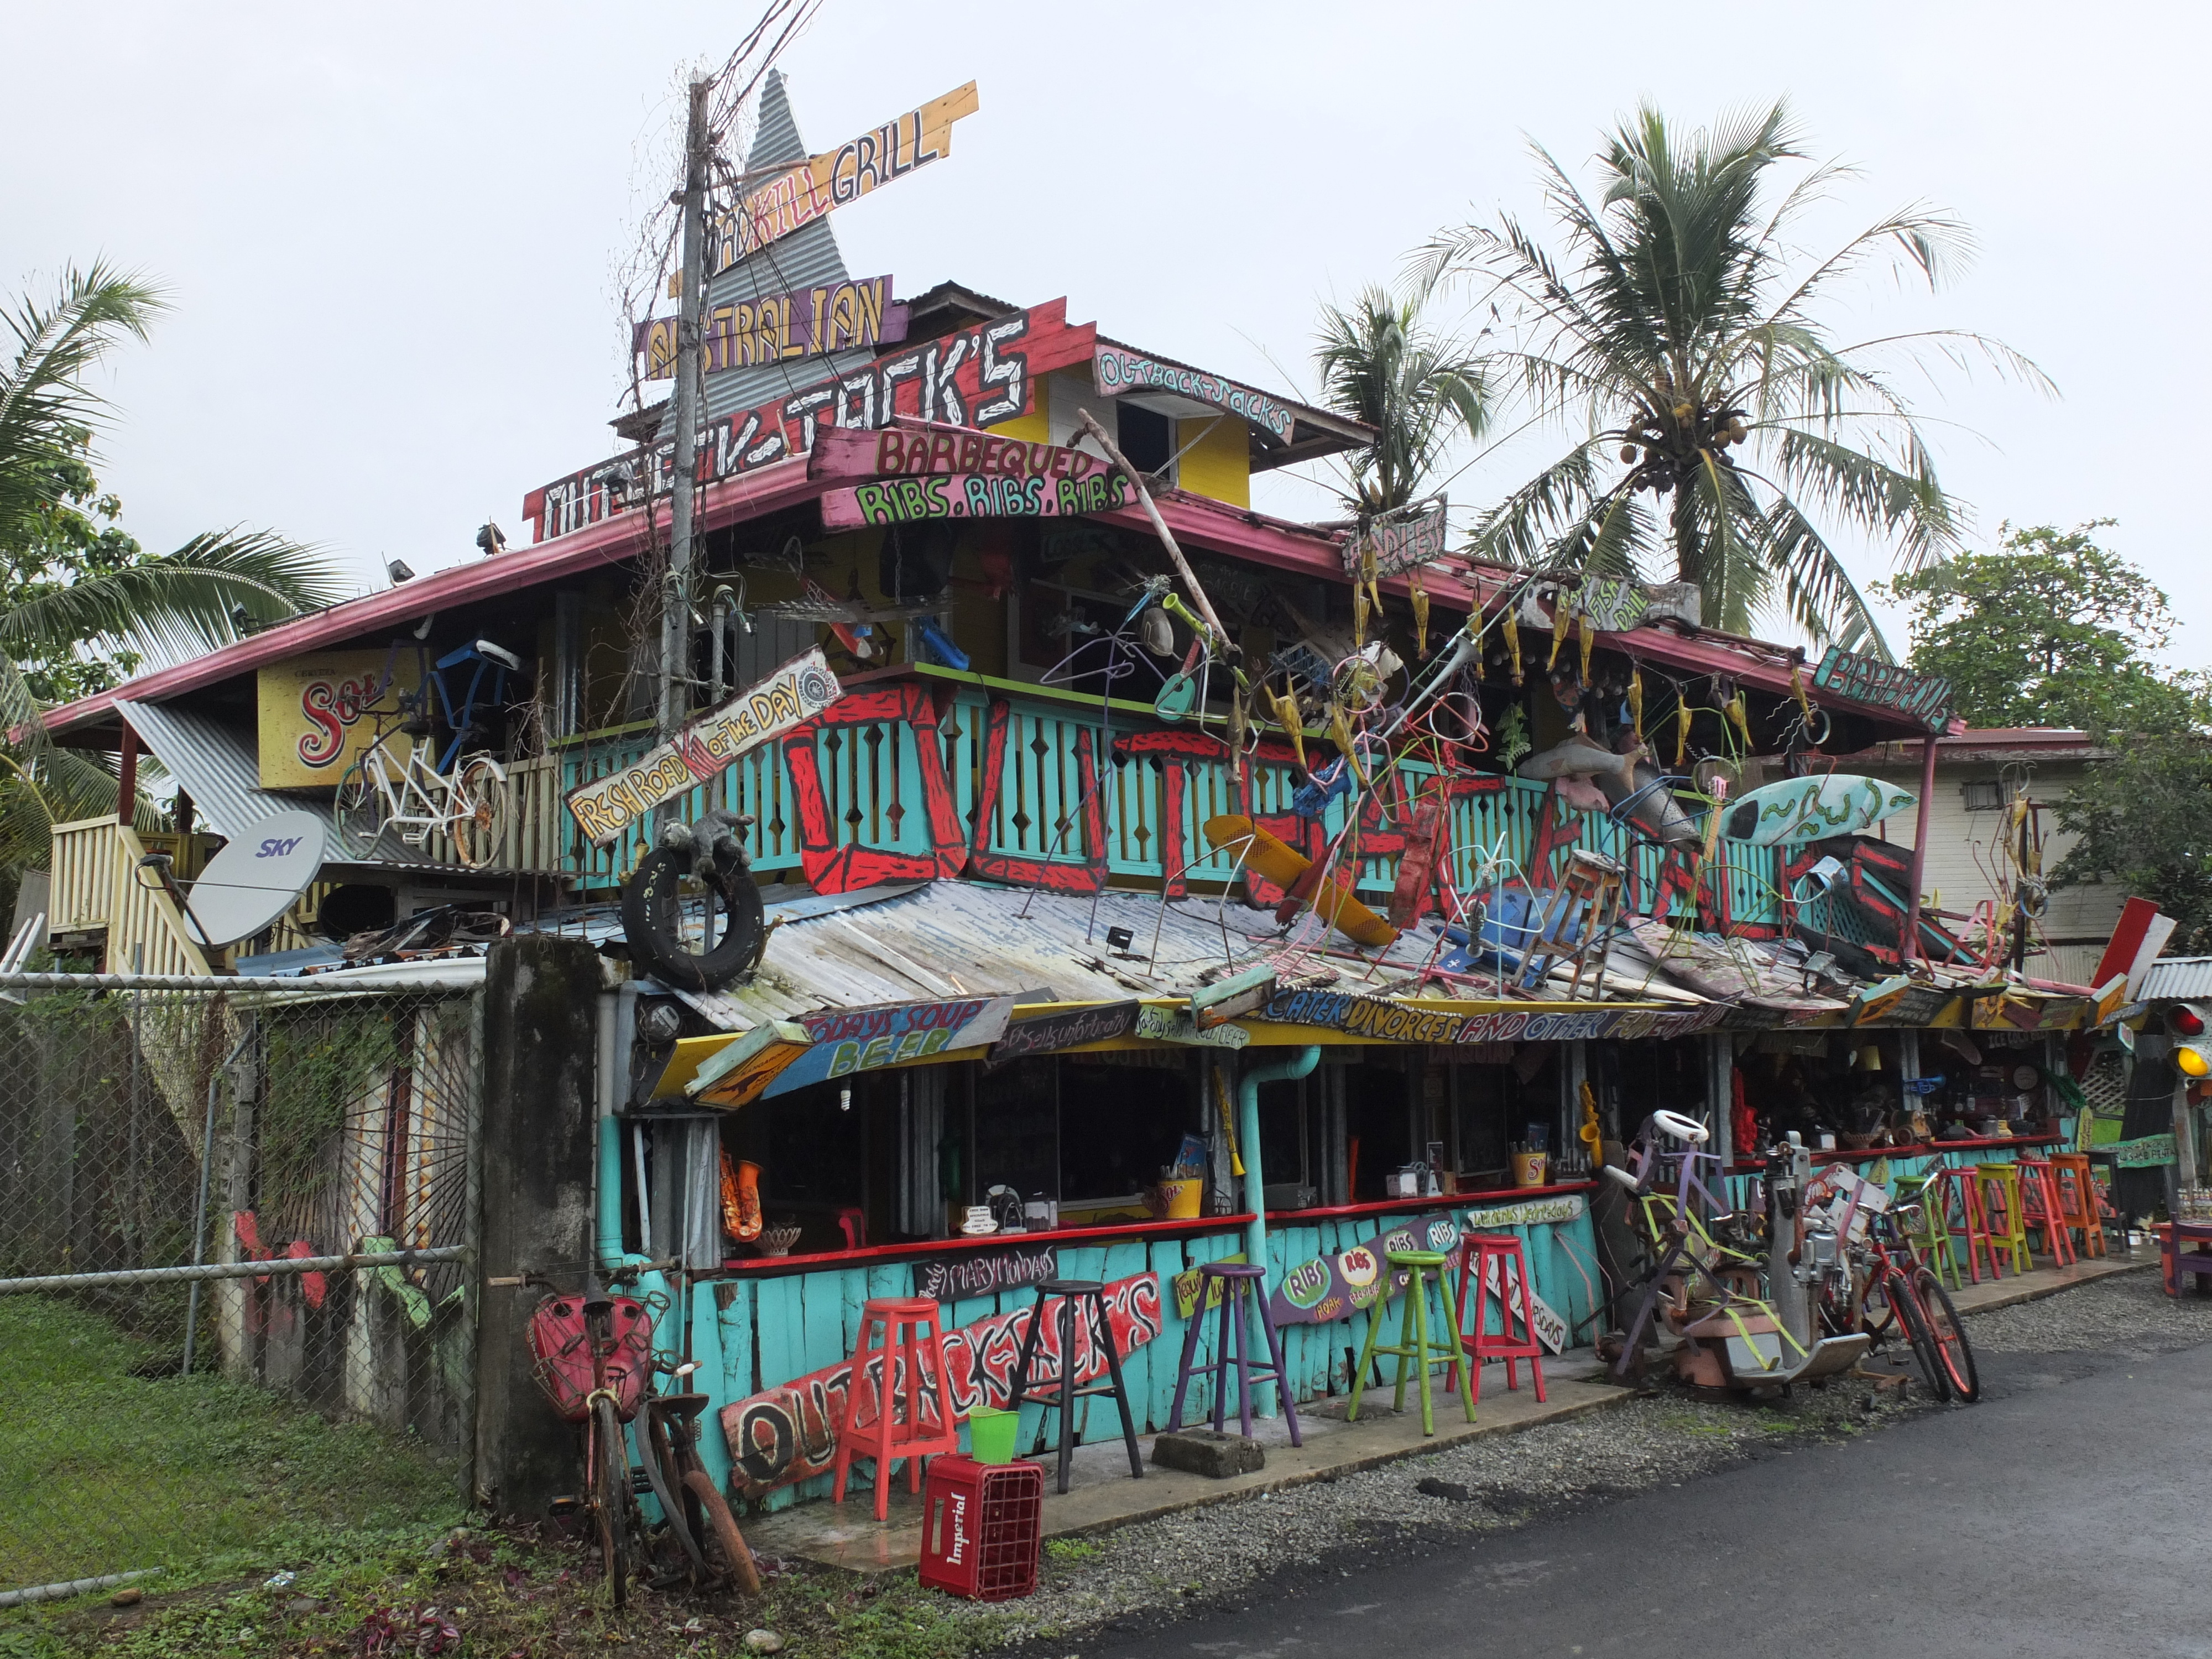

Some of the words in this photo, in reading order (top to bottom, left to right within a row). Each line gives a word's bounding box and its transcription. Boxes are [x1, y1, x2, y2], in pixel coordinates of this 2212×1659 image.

[830, 109, 938, 208] GRILL
[647, 278, 884, 381] ASTRALIAN
[878, 429, 1094, 480] BARBEQUED
[1057, 474, 1128, 515] RIBS
[1588, 580, 1620, 626] FISH
[570, 777, 644, 839] FRESH
[629, 754, 688, 805] ROAD
[708, 732, 732, 759] OF
[727, 711, 757, 745] THE
[750, 674, 804, 730] DAY
[255, 836, 304, 859] SKY
[895, 1000, 983, 1039] SOUP
[1218, 1024, 1247, 1047] BEER
[1266, 989, 1352, 1023] CATER
[1347, 997, 1463, 1044] DIVORCES
[1458, 1010, 1530, 1044] AND
[1524, 1011, 1606, 1041] OTHER
[828, 1026, 952, 1079] BEER
[1988, 1032, 2007, 1049] ICE
[1387, 1233, 1414, 1251] RIBS
[1429, 1222, 1455, 1249] RIBS
[1287, 1259, 1325, 1298] RIBS
[1344, 1251, 1371, 1272] RIBS
[1316, 1296, 1342, 1321] PORK
[947, 1492, 969, 1566] Imperial
